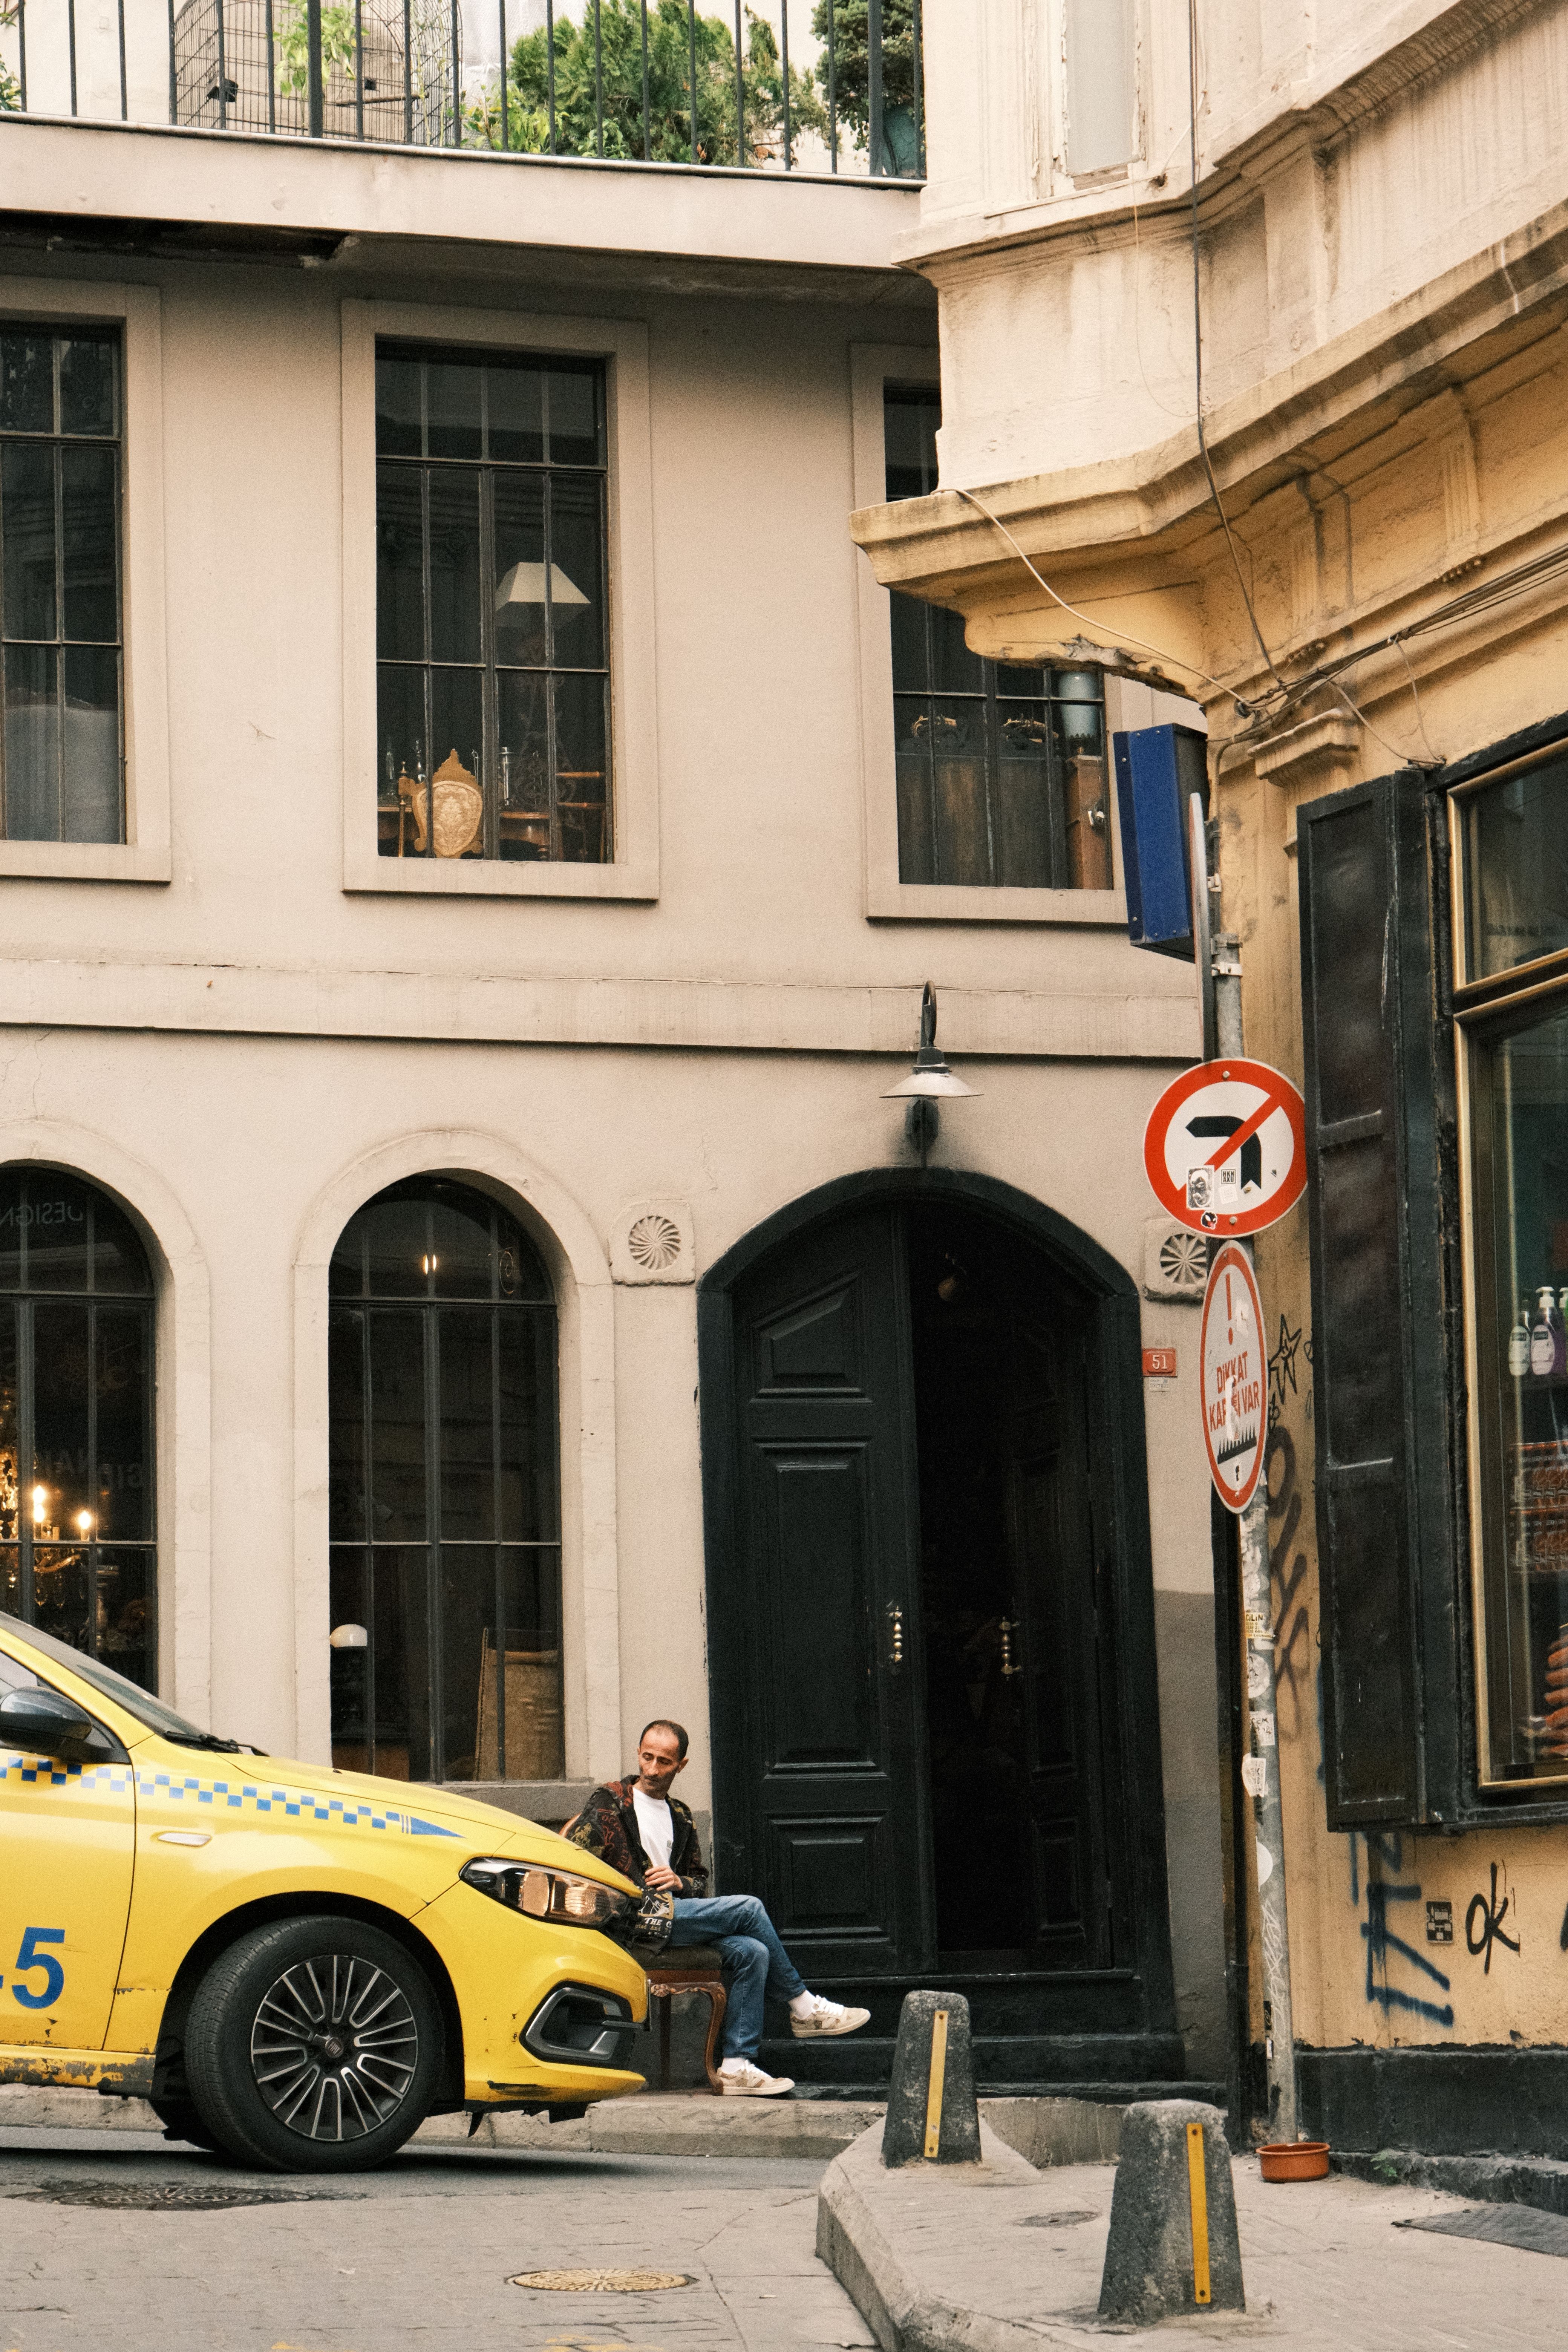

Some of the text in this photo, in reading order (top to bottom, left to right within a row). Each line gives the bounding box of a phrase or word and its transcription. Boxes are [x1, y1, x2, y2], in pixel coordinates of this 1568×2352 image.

[1152, 1355, 1168, 1369] 51
[1241, 1381, 1260, 1414] VAR
[644, 1917, 663, 1926] THE
[328, 2041, 340, 2055] FIAT
